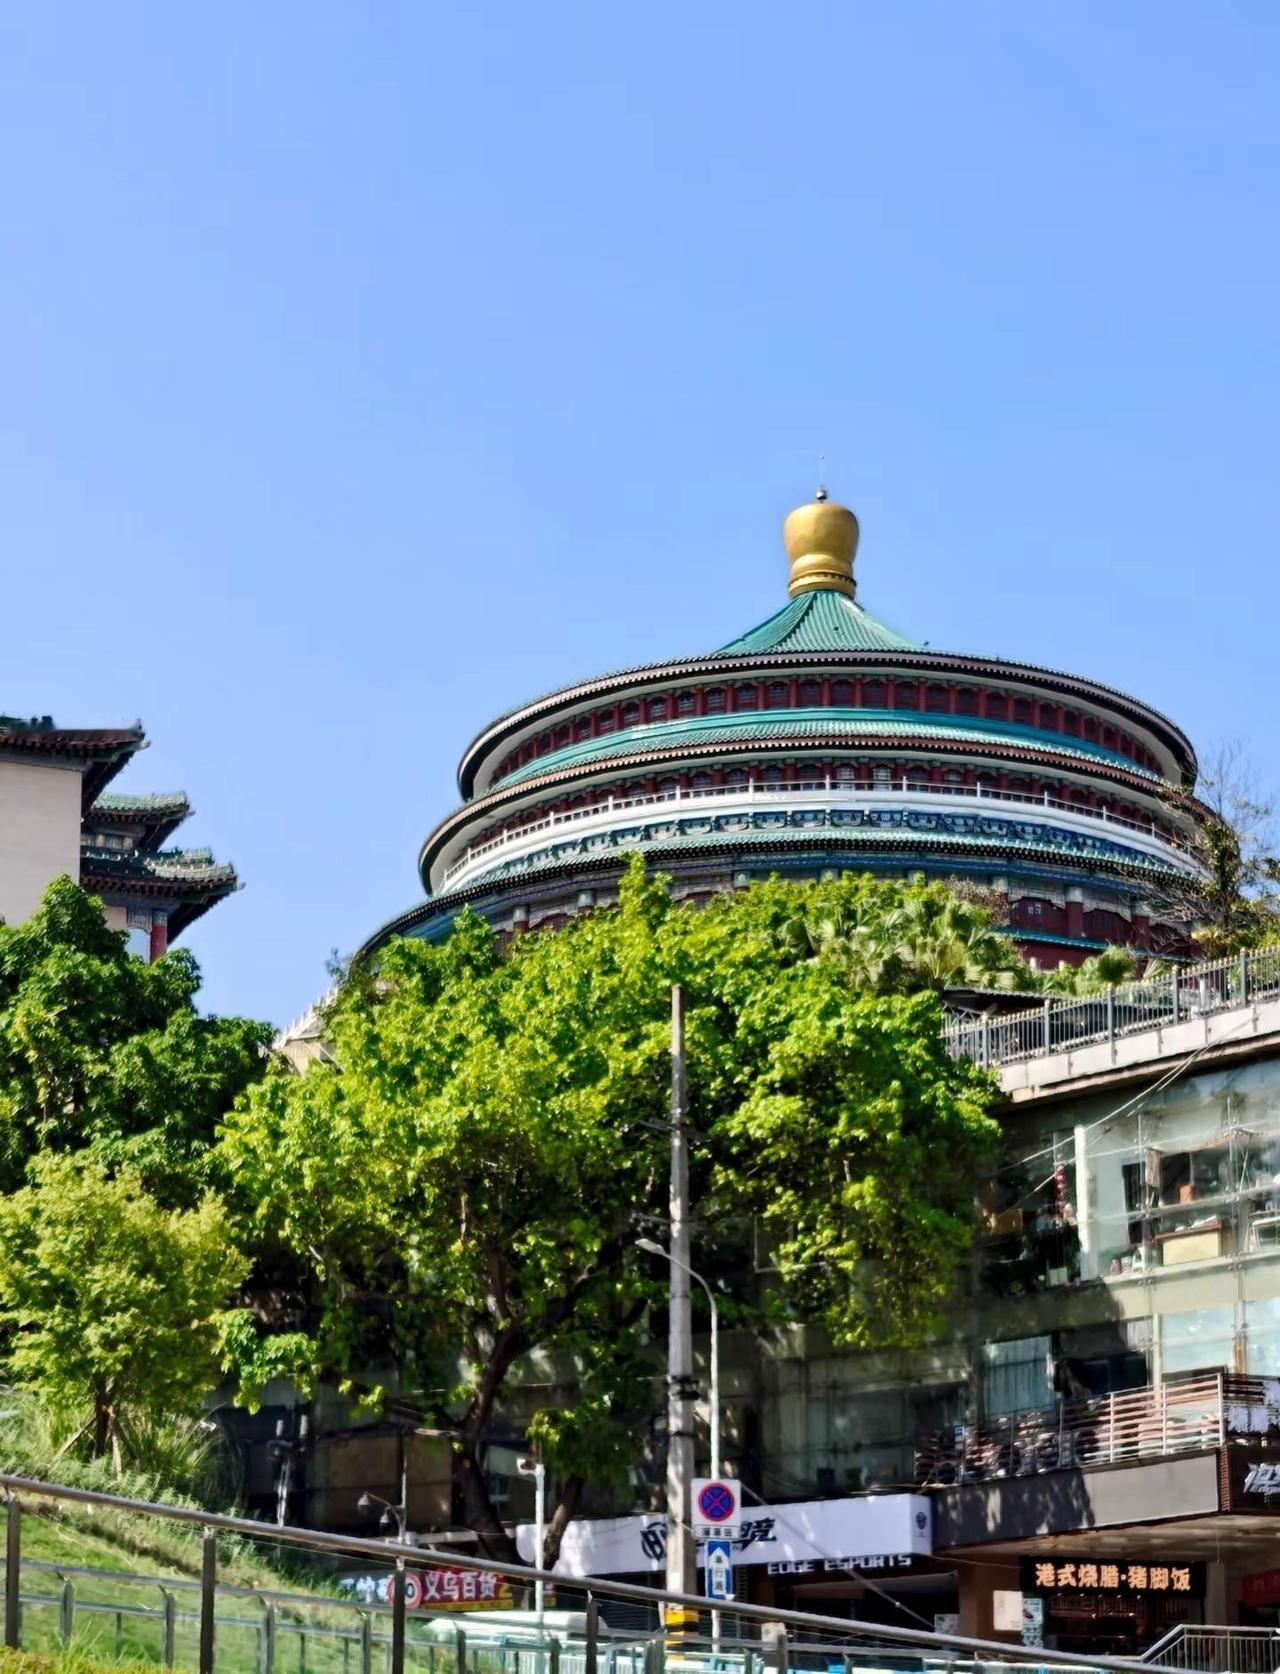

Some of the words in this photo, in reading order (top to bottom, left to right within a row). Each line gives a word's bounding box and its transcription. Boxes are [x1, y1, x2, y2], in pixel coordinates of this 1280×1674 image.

[824, 1554, 911, 1571] ESPORTS
[424, 1571, 497, 1601] 义乌百货
